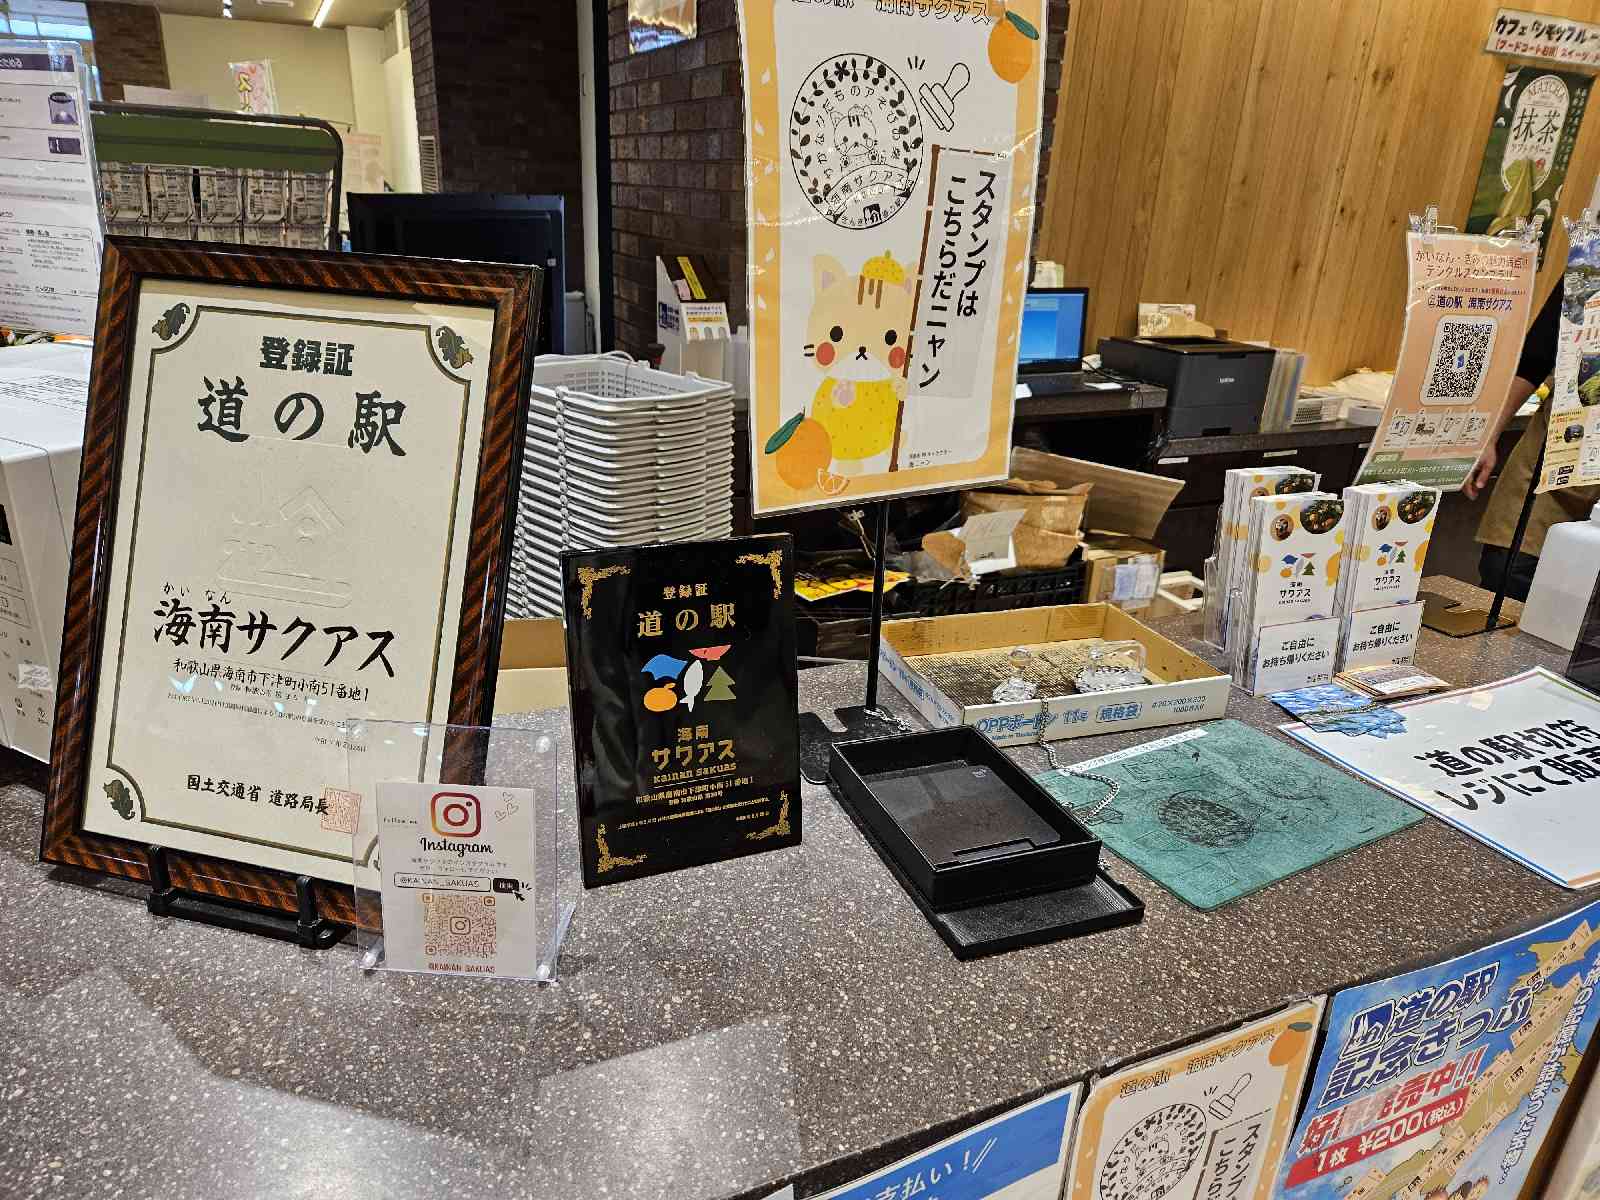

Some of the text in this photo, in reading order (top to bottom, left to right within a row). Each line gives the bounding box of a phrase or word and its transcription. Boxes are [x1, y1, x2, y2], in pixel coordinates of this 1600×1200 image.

[1512, 107, 1561, 144] 抹茶
[956, 170, 996, 318] スタンプは
[919, 175, 967, 388] こちらだニャン
[259, 335, 354, 377] 登録証
[197, 376, 407, 457] 道の駅
[663, 582, 708, 600] 登録証
[1279, 588, 1312, 599] サクアス
[1375, 575, 1401, 586] サクアス
[153, 598, 396, 678] 海南サクアス
[637, 602, 736, 639] 道の駅
[1369, 621, 1401, 636] ご自由に
[1262, 650, 1330, 669] お持ち帰りください
[1281, 637, 1315, 652] ご自由に
[1352, 633, 1413, 653] お持ち帰りください
[173, 657, 369, 702] 和歌山県海南市下津町小南51番地1
[651, 739, 736, 770] サクアス
[1413, 719, 1600, 778] 道の駅切符
[187, 774, 262, 802] 国土交通省
[269, 790, 329, 816] 道路局長
[419, 837, 494, 857] Instagram
[1388, 961, 1500, 1035] 道の駅
[1317, 1147, 1348, 1172] 1枚
